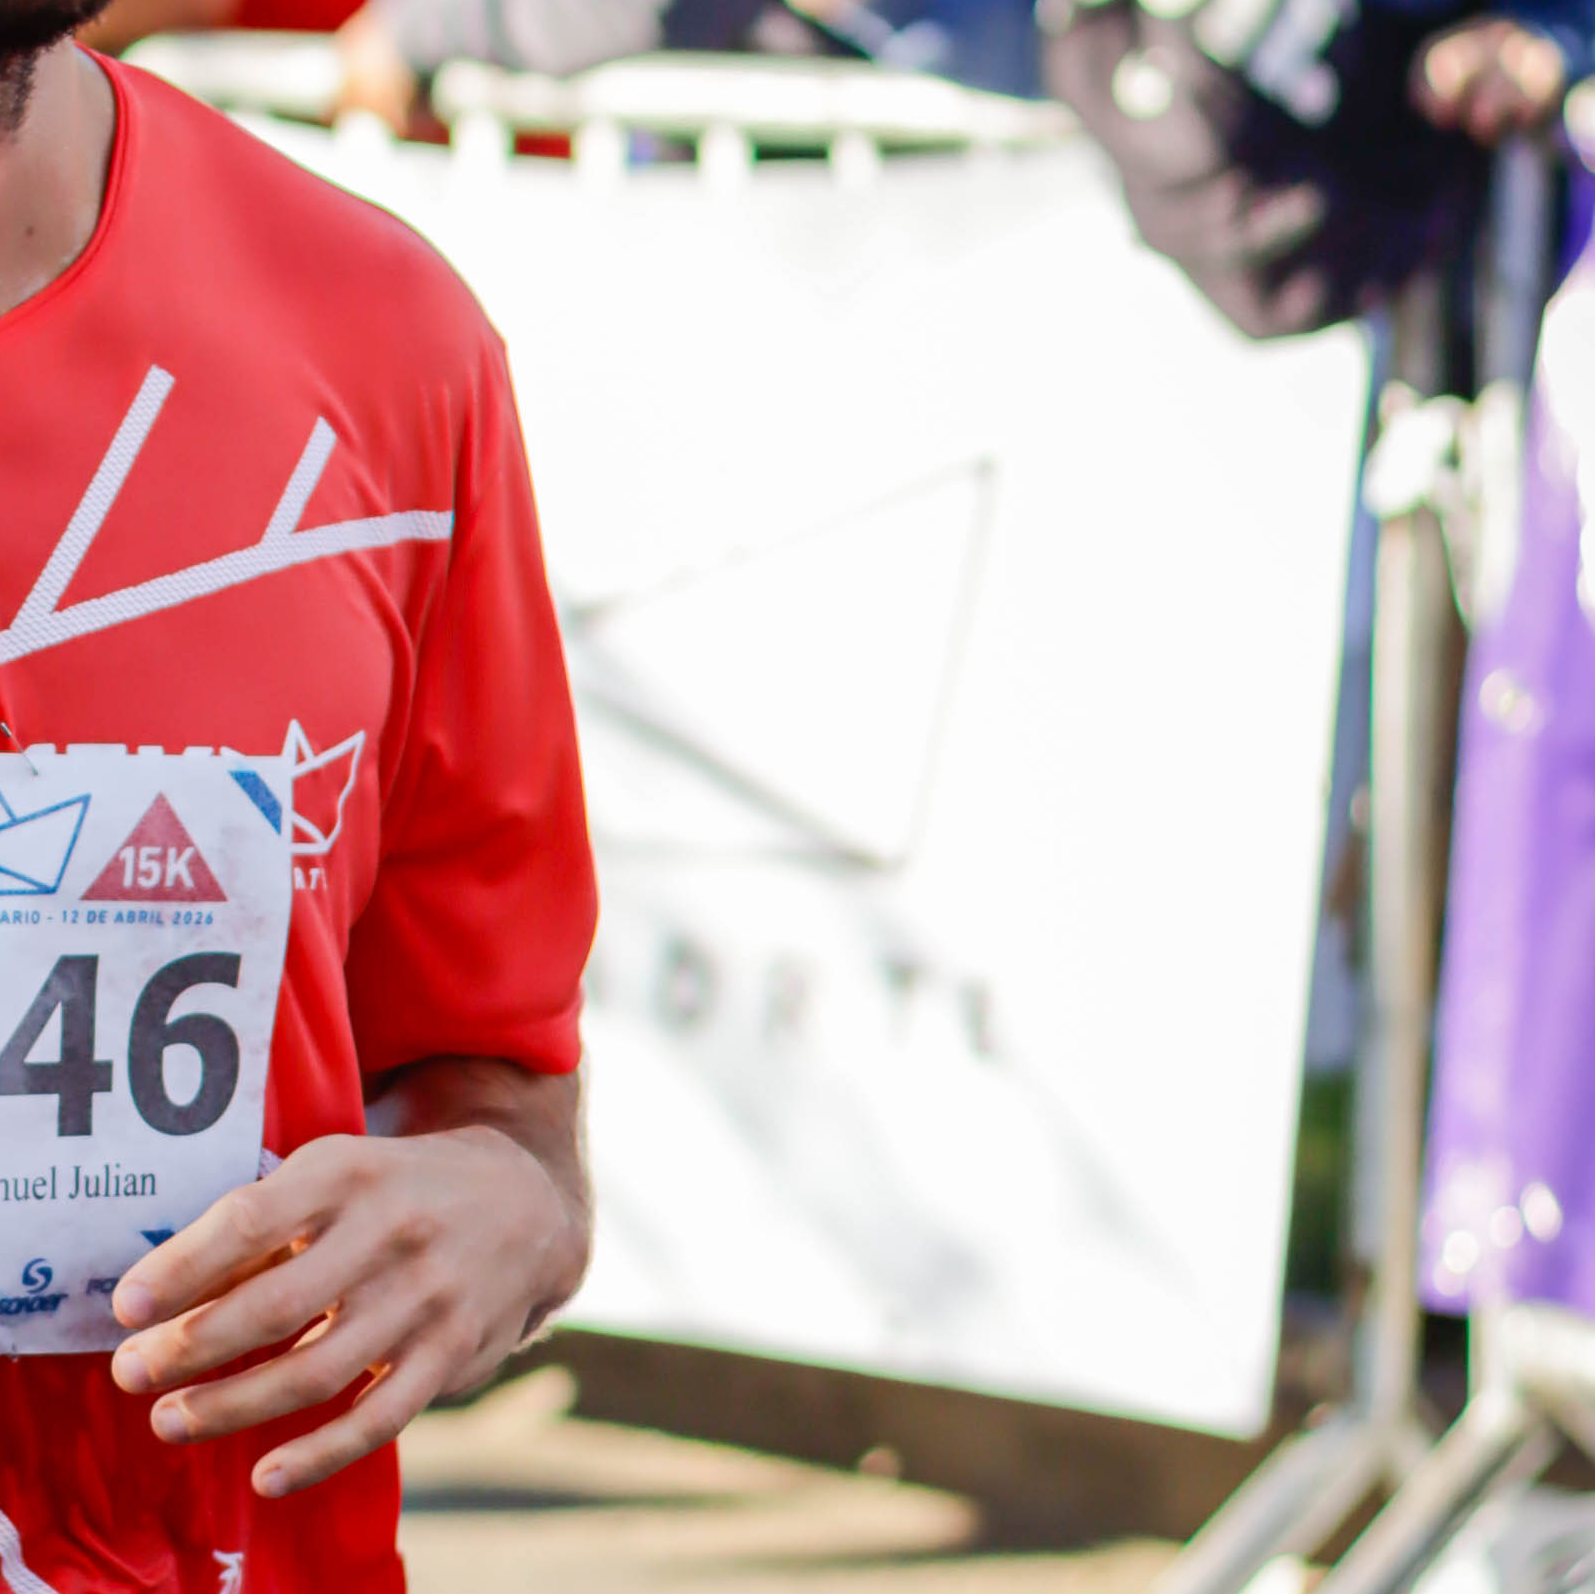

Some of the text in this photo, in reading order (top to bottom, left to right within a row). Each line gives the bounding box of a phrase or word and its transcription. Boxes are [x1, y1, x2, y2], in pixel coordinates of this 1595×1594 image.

[117, 845, 197, 889] 15K
[61, 909, 80, 924] 12
[86, 910, 108, 924] DE
[113, 910, 165, 927] ABRIL
[171, 910, 214, 925] 2026
[67, 1165, 158, 1200] Julian
